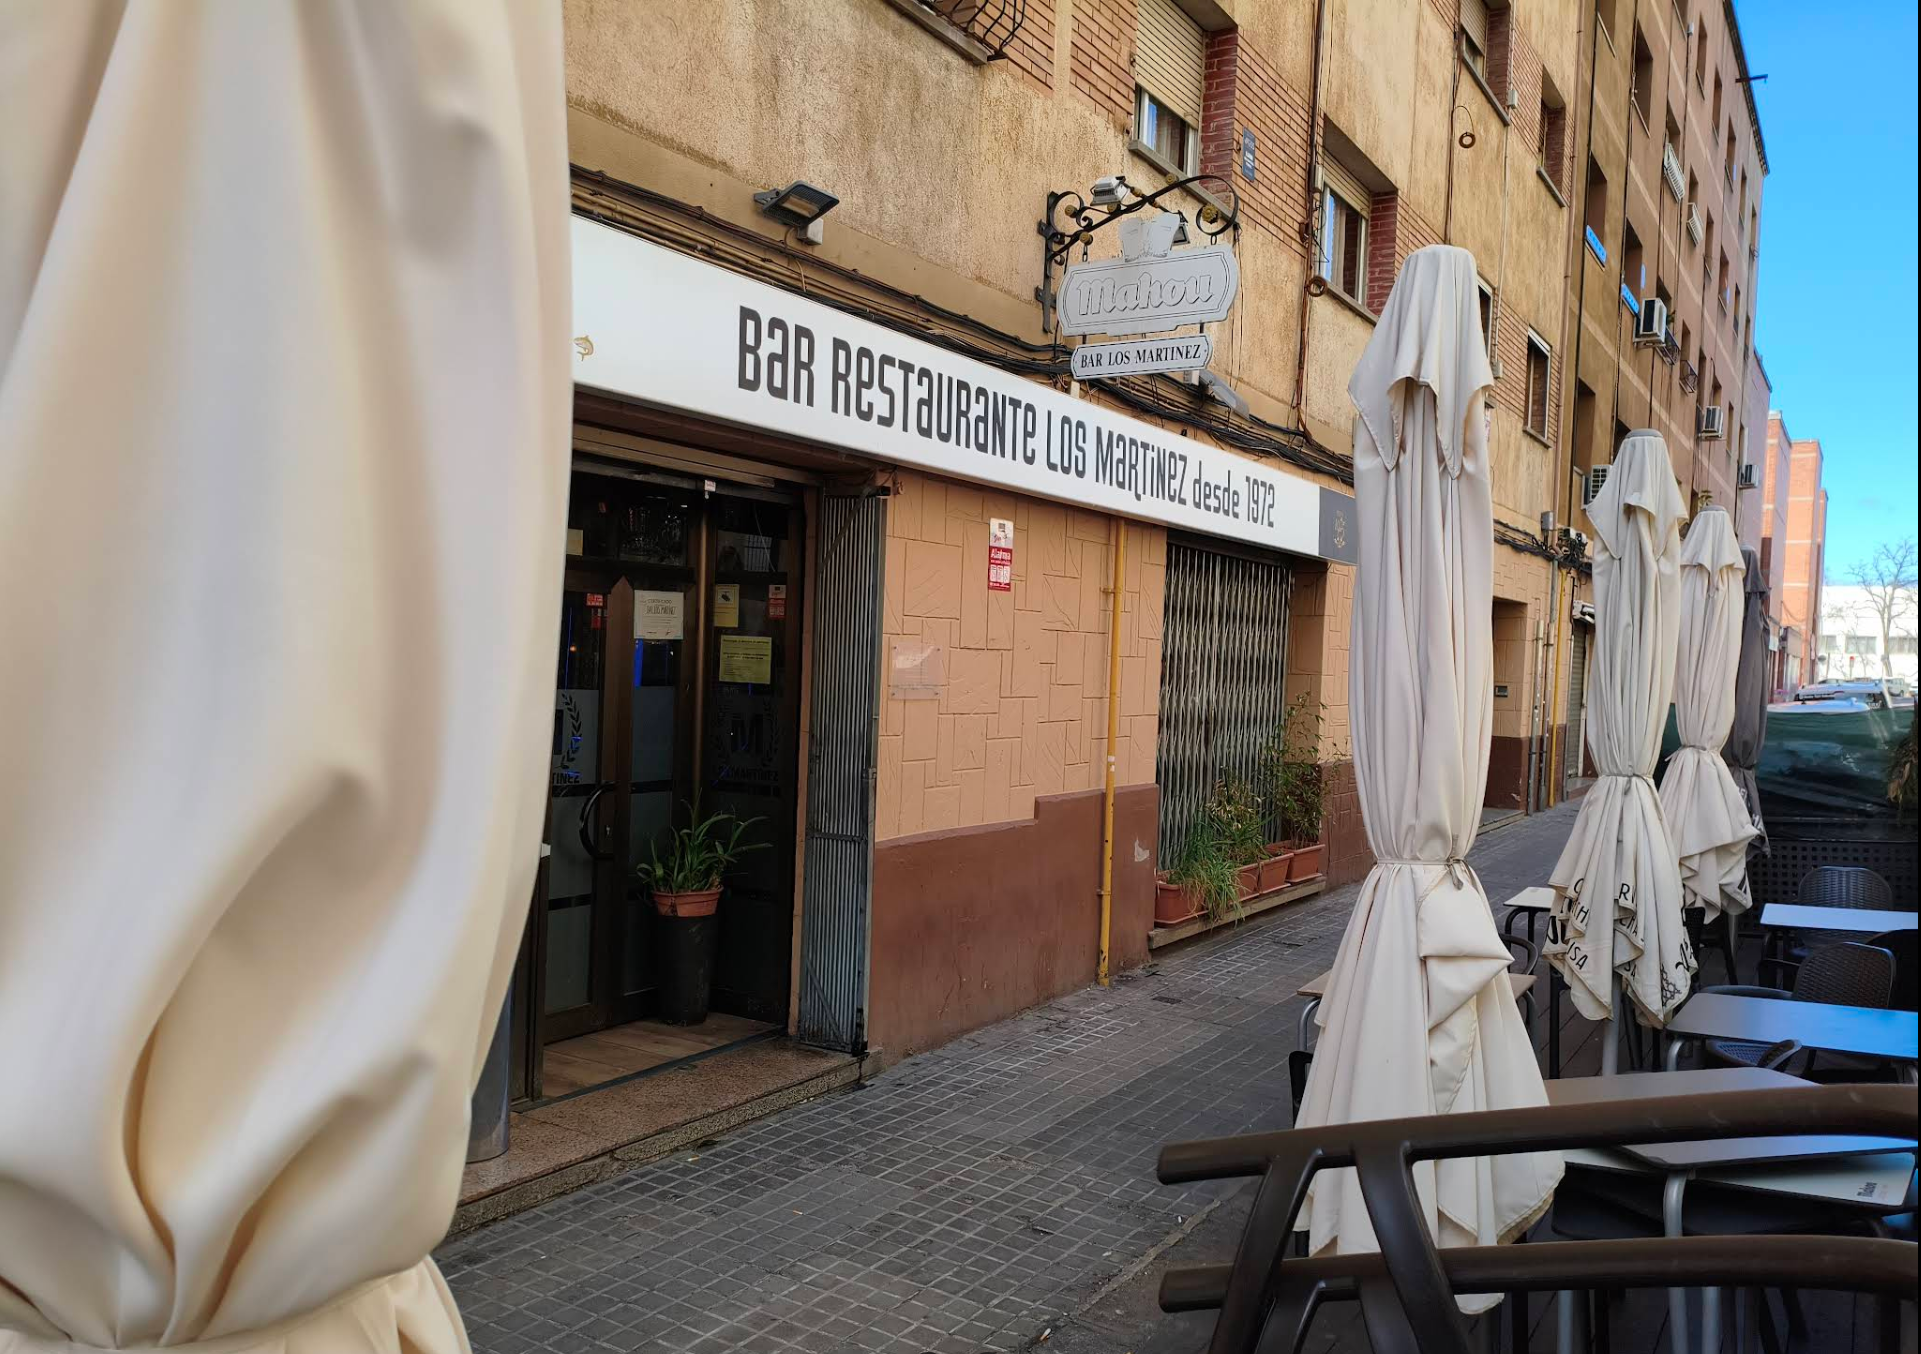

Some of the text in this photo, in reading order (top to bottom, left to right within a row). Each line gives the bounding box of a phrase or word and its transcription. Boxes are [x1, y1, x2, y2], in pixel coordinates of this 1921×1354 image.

[1077, 272, 1214, 316] Mahou
[1080, 344, 1201, 369] BAR LOS MARTINEZ
[1192, 460, 1240, 520] desde
[1245, 475, 1275, 529] 1972
